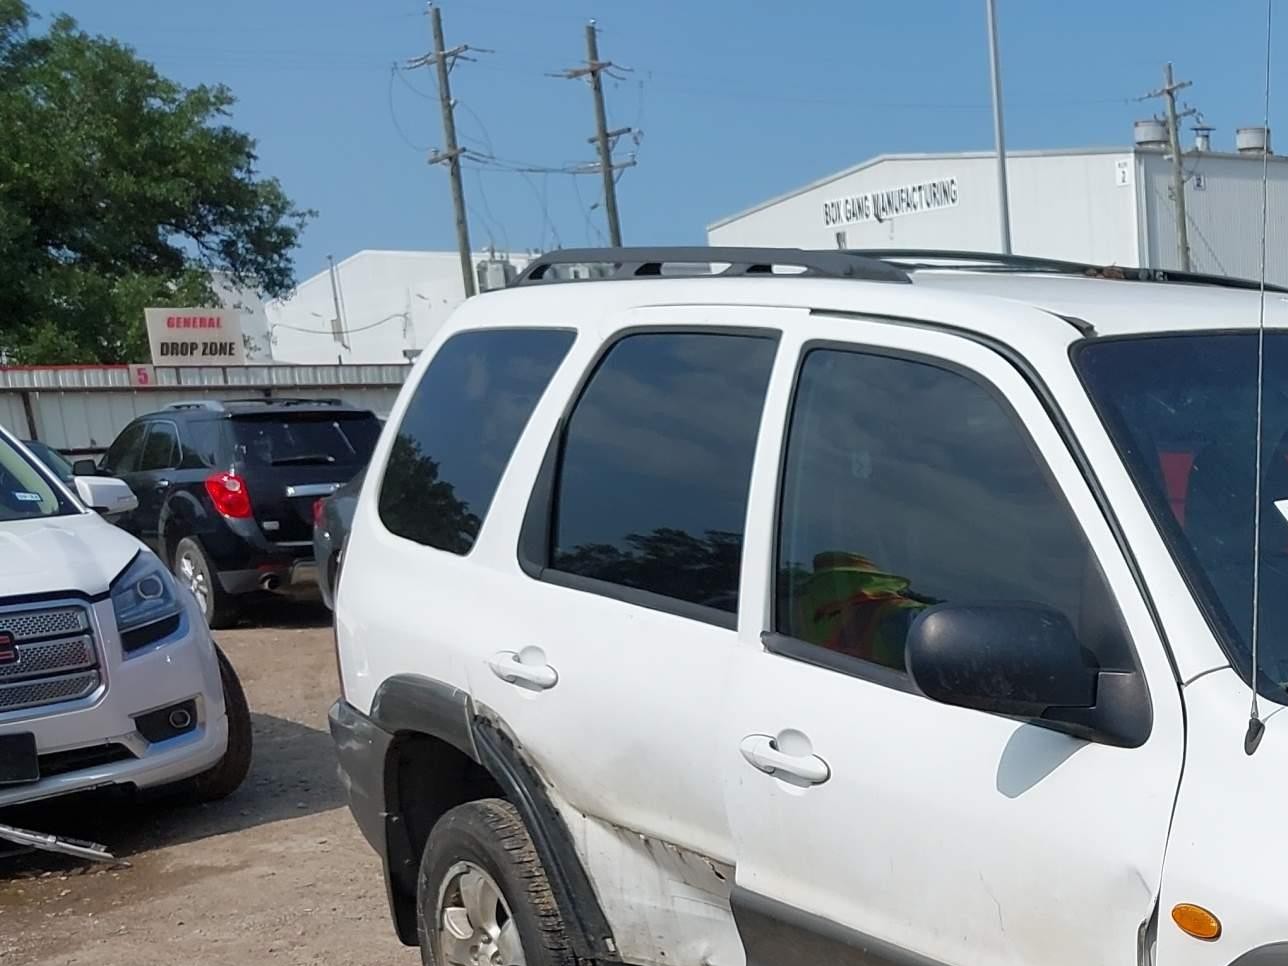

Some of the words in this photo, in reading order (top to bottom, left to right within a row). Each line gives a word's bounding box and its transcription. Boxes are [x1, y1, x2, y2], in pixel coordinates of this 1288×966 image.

[824, 200, 843, 225] BOX
[872, 179, 957, 217] MANUFACTURING
[166, 316, 222, 328] GENERAL
[160, 342, 198, 356] DROP
[201, 342, 235, 356] ZONE
[137, 368, 149, 385] 5
